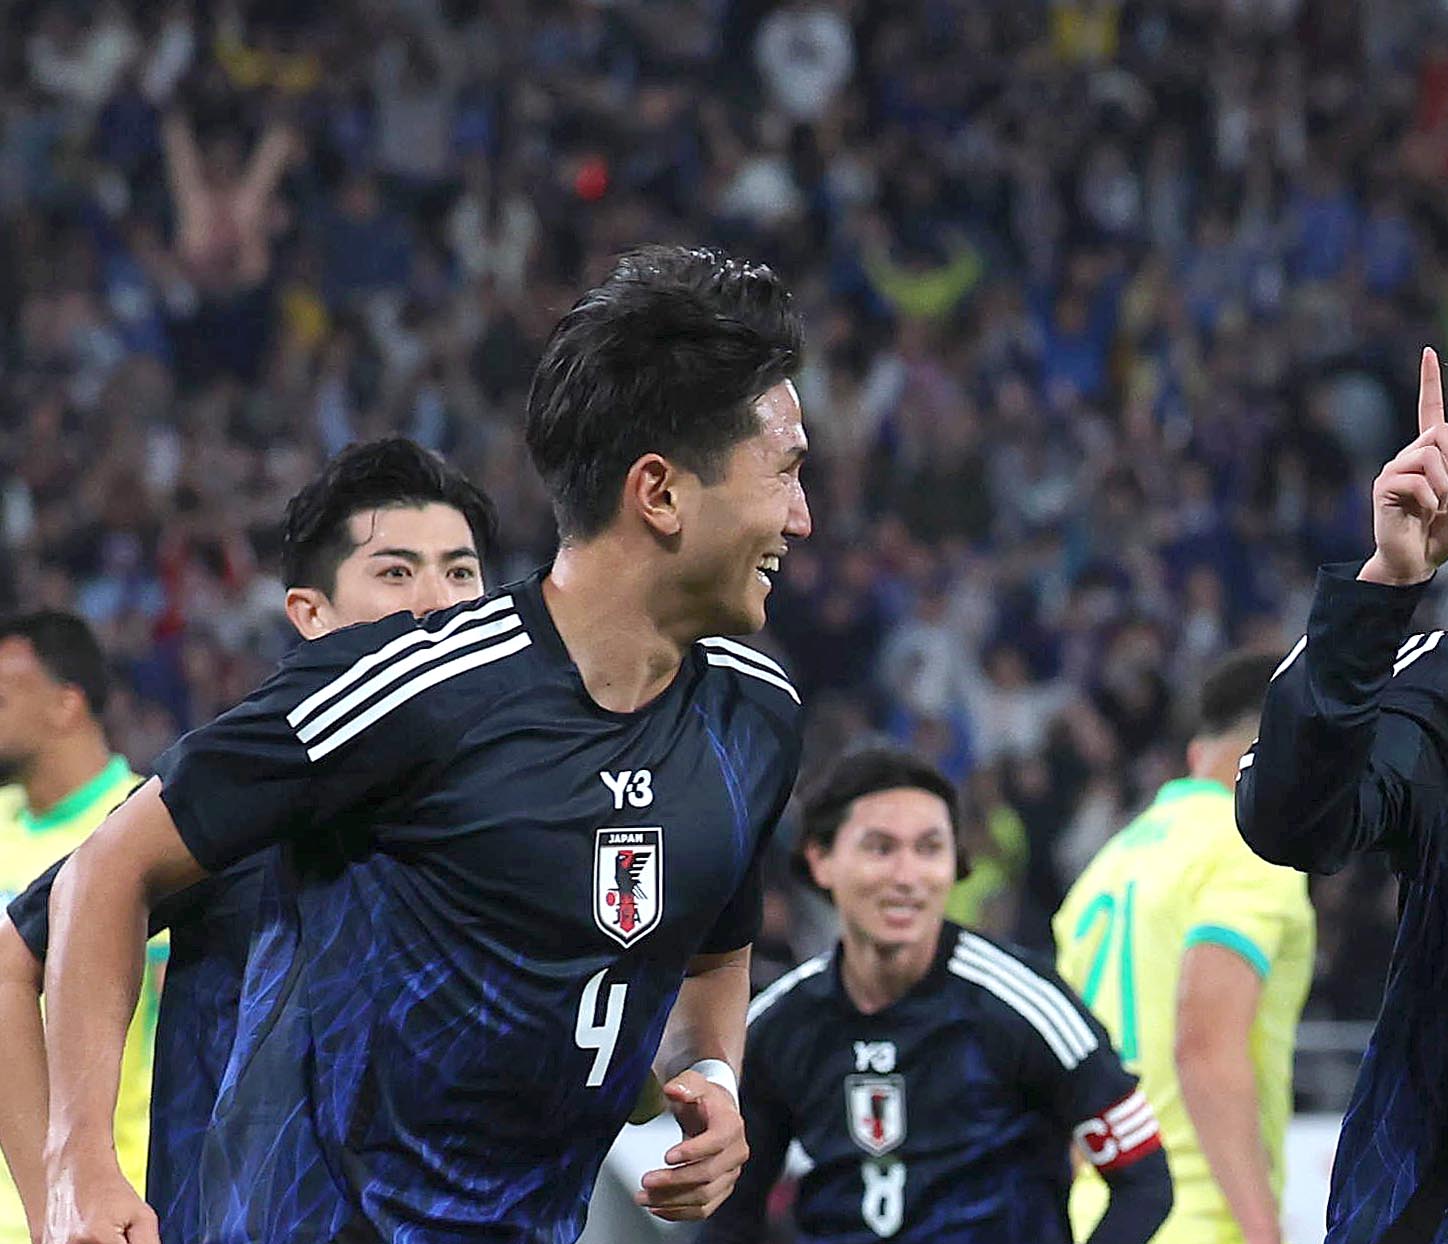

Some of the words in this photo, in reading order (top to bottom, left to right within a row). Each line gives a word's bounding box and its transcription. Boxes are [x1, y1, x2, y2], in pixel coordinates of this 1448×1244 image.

[599, 769, 654, 810] Y-3
[608, 833, 645, 844] JAPAN
[574, 969, 627, 1087] 4
[1073, 1118, 1119, 1166] C
[861, 1162, 906, 1238] 8
